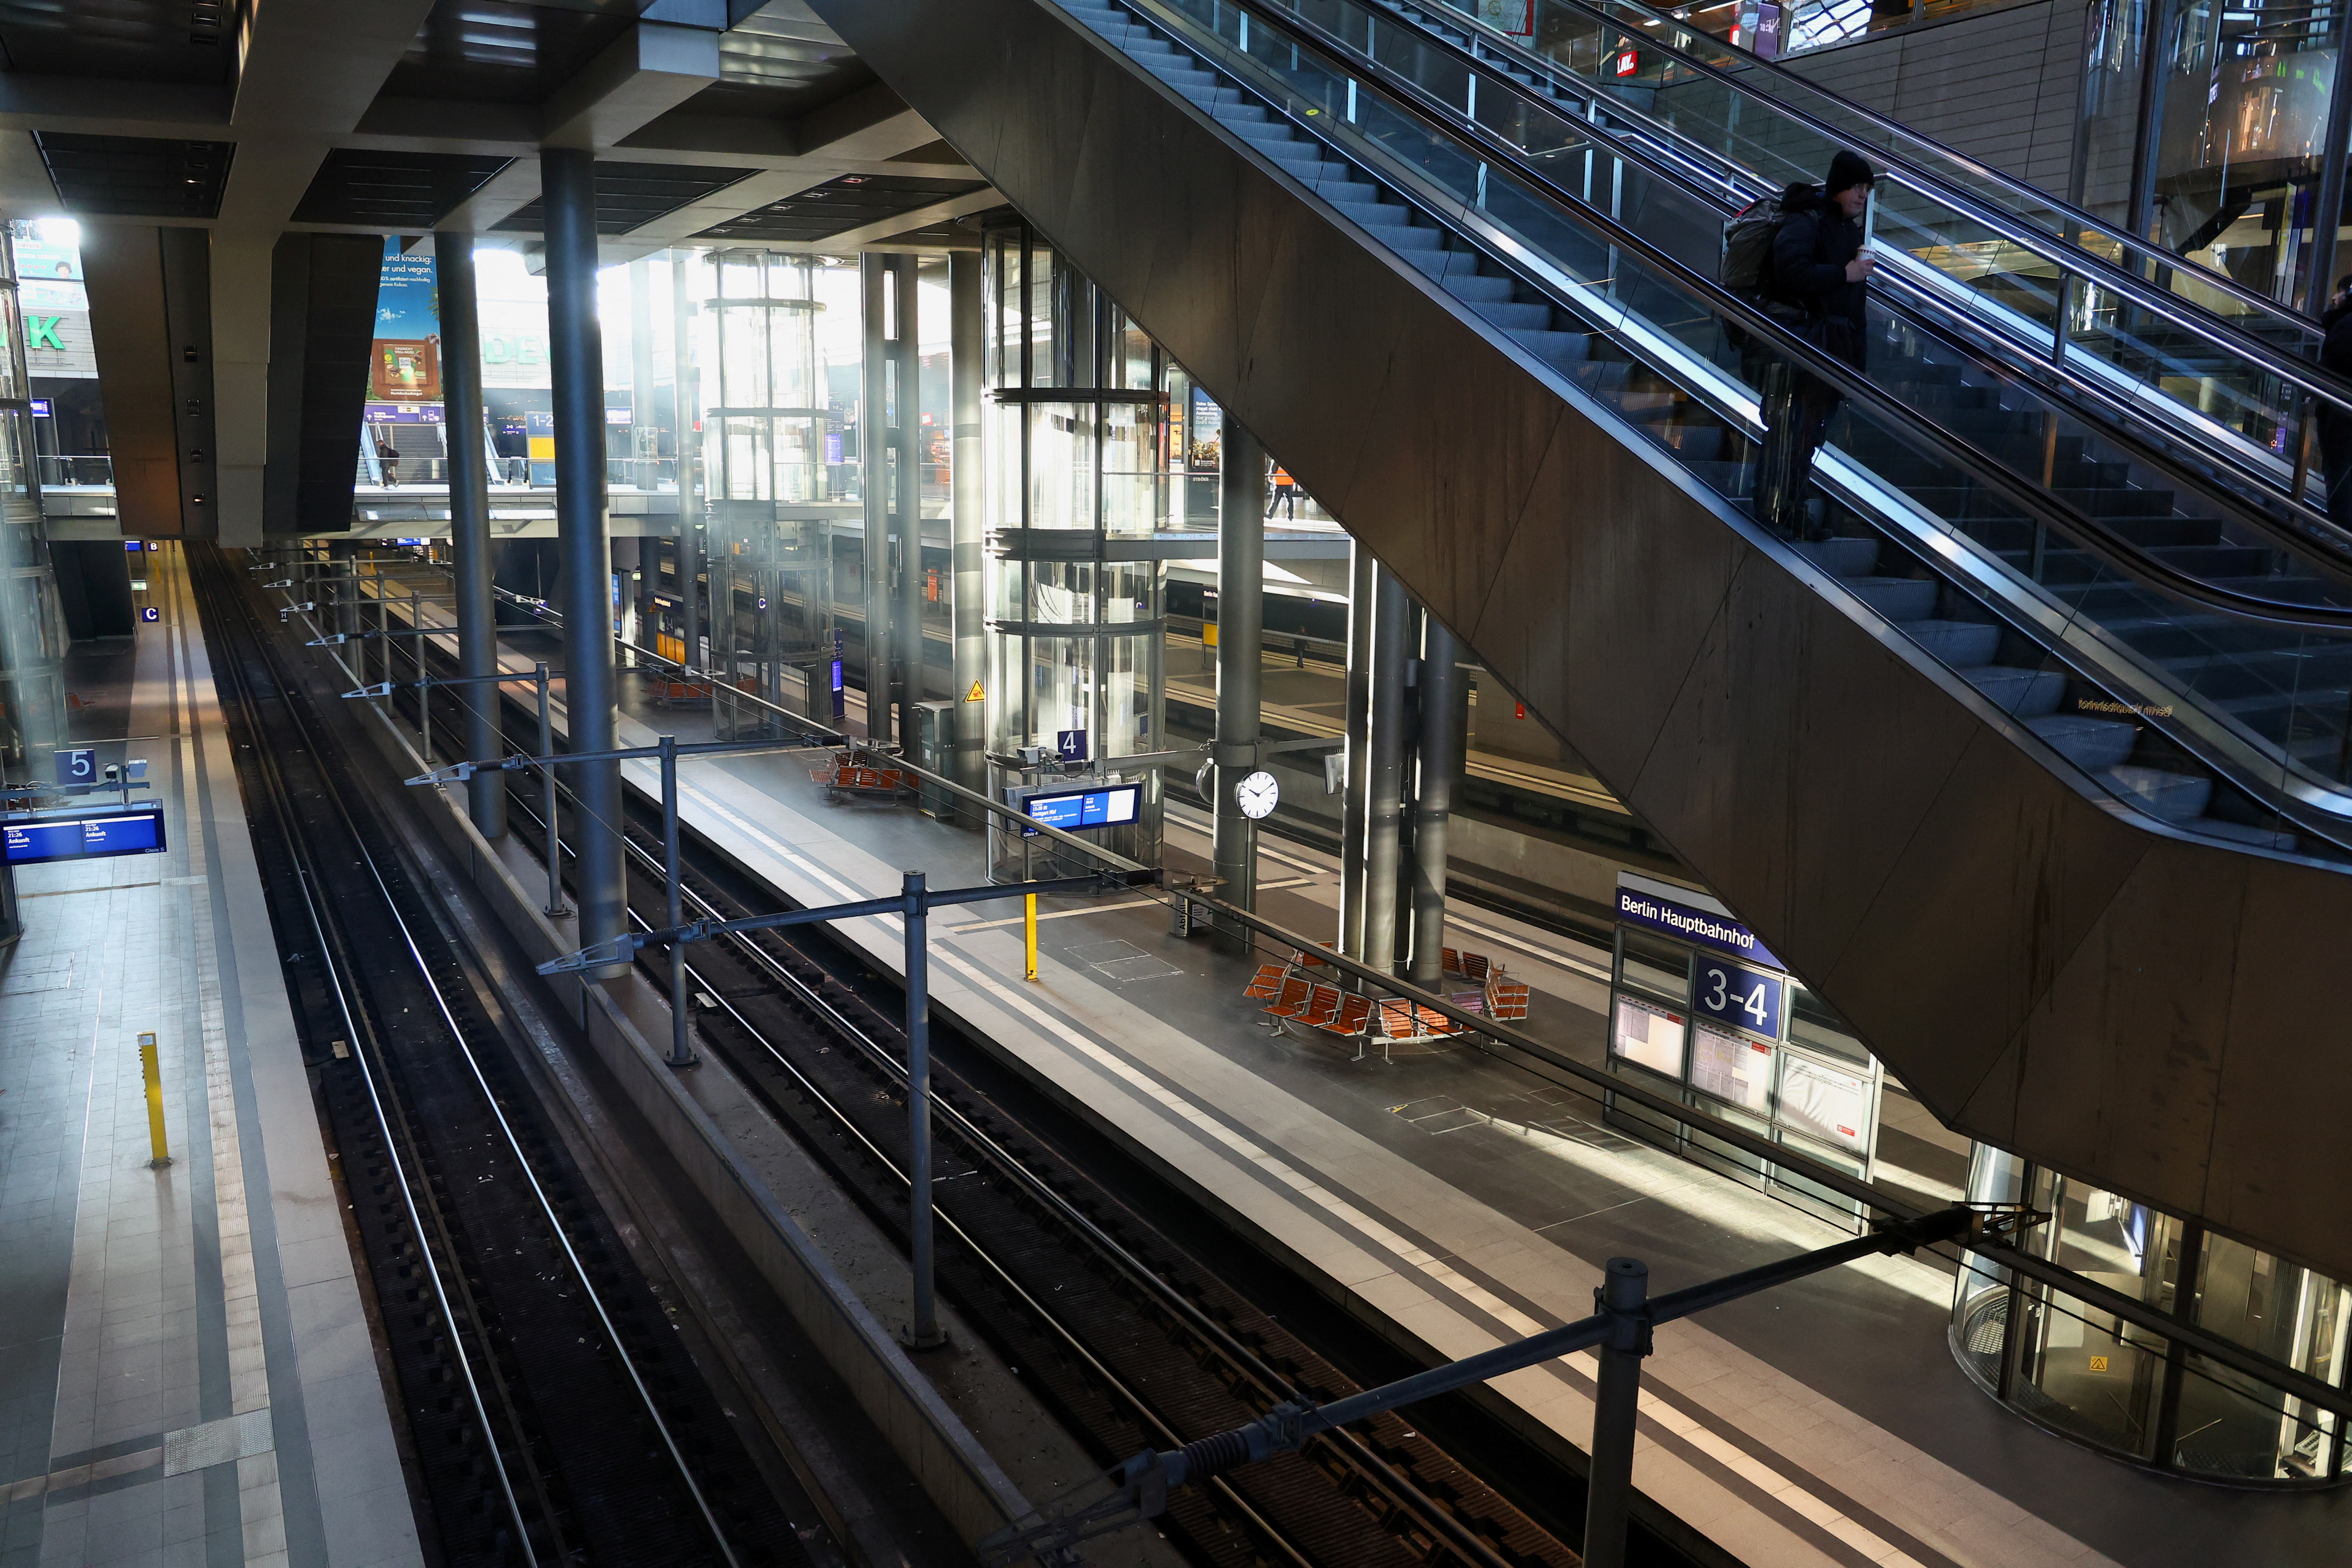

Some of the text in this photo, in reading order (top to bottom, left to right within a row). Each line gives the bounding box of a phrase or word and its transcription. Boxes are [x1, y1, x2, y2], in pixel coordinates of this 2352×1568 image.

[385, 254, 432, 265] und knackig:
[392, 264, 406, 272] und
[759, 598, 766, 608] C
[146, 608, 157, 620] C
[1063, 731, 1077, 754] 4
[71, 751, 90, 776] 5
[1621, 895, 1755, 949] Berlin Hauptbahnhof
[1704, 969, 1767, 1026] 3-4
